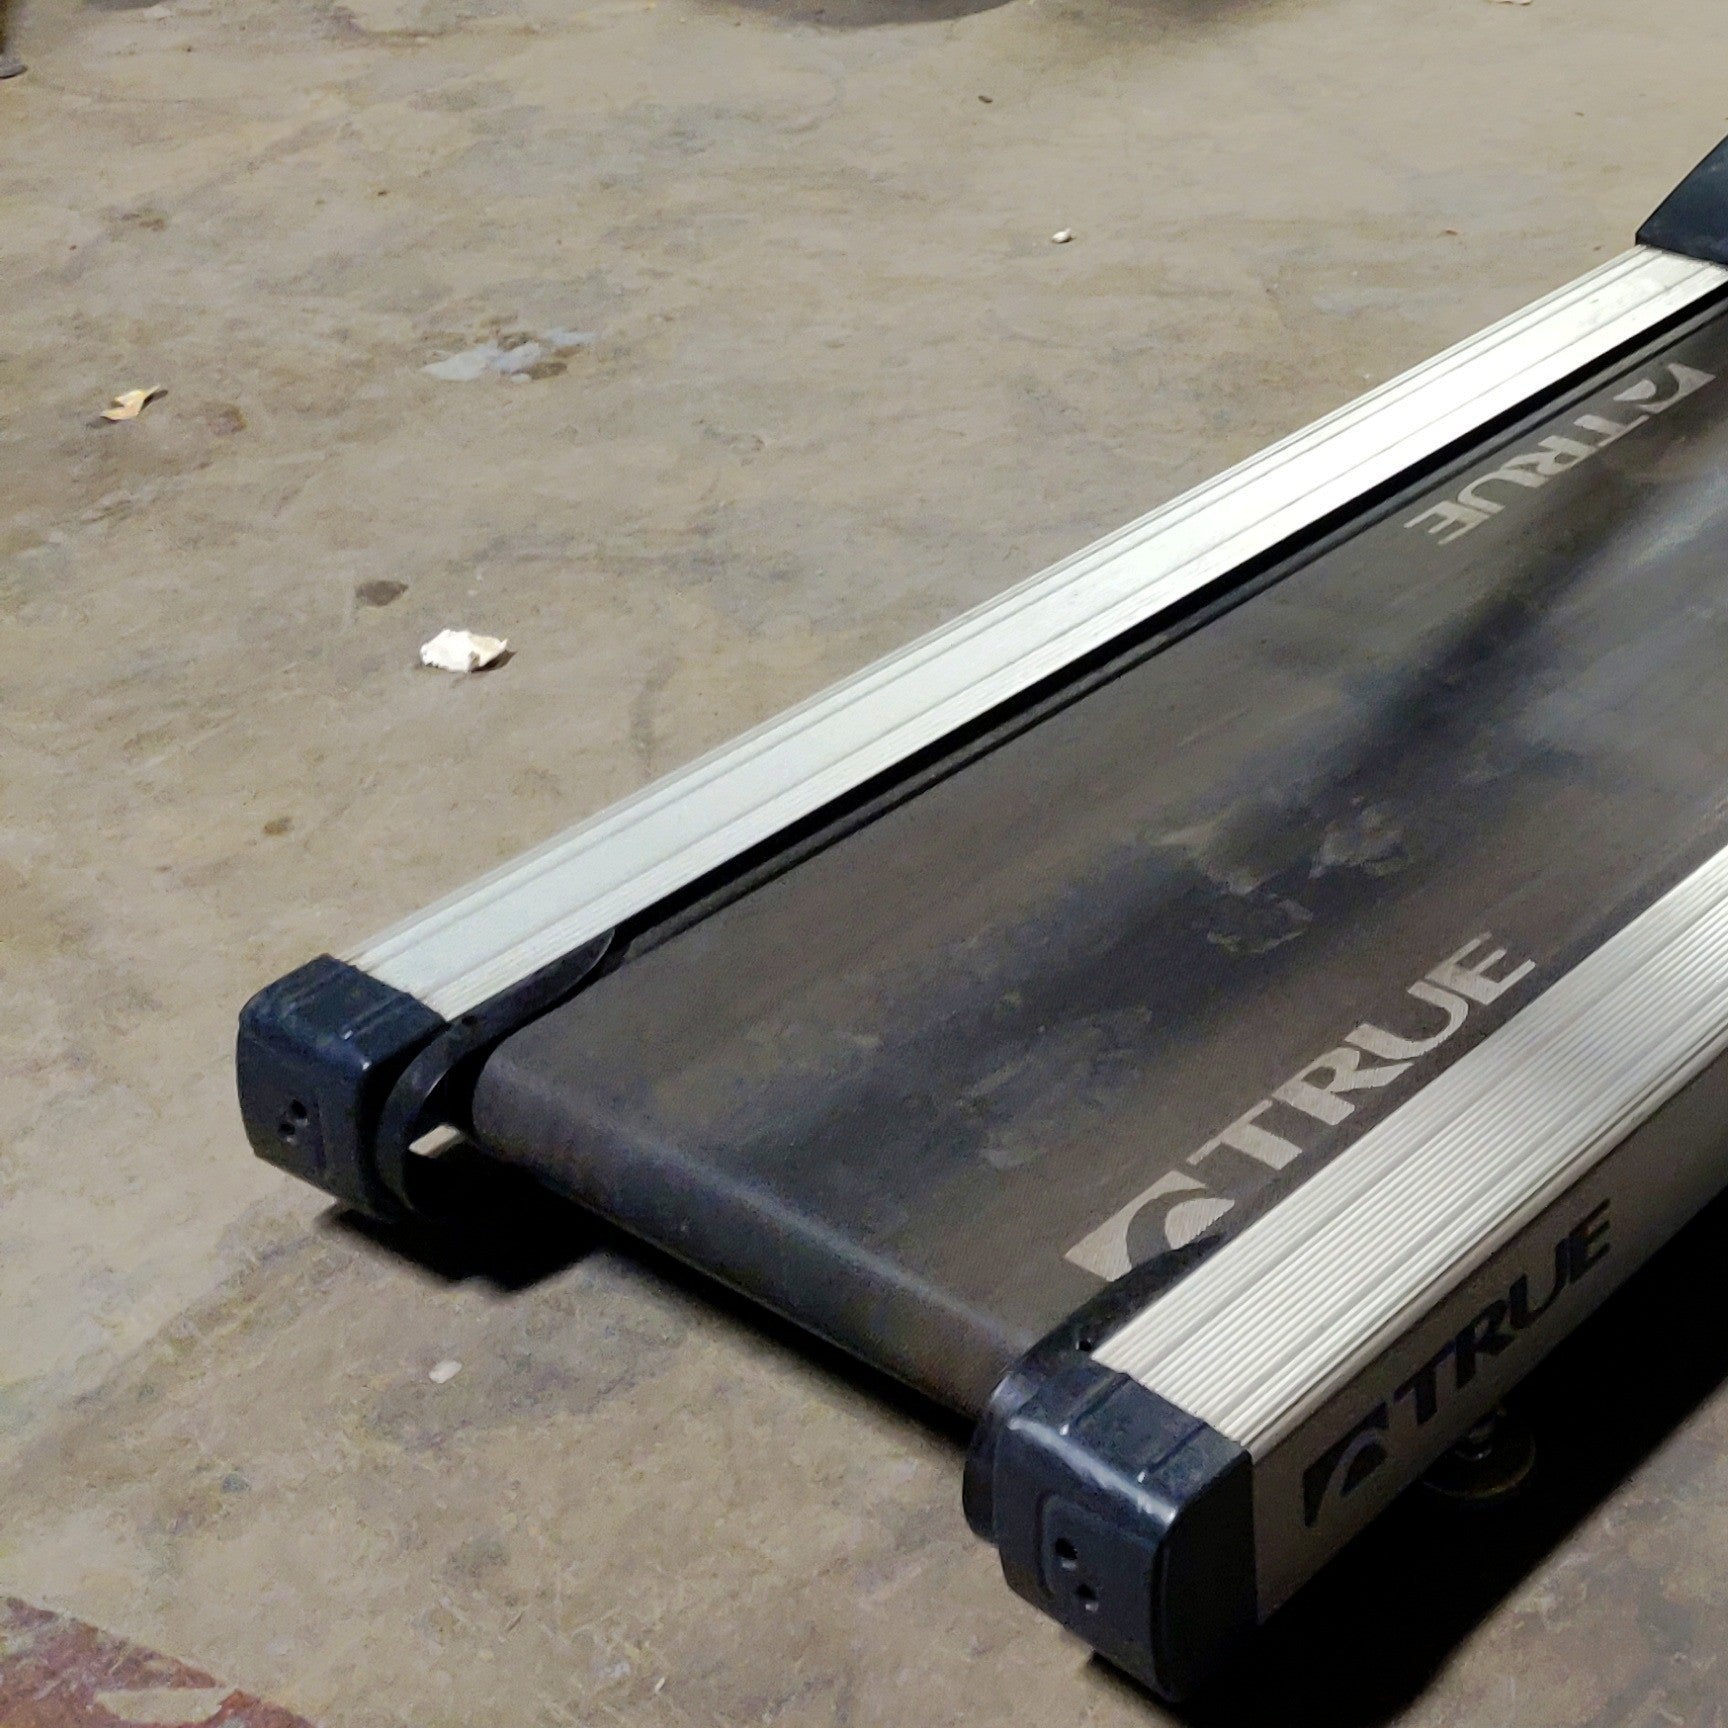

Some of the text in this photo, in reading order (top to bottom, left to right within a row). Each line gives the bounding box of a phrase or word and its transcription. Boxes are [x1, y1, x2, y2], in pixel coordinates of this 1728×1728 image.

[1403, 413, 1650, 546] TRUE
[1186, 930, 1537, 1171] TRUE
[1393, 1197, 1611, 1425] TRUE
